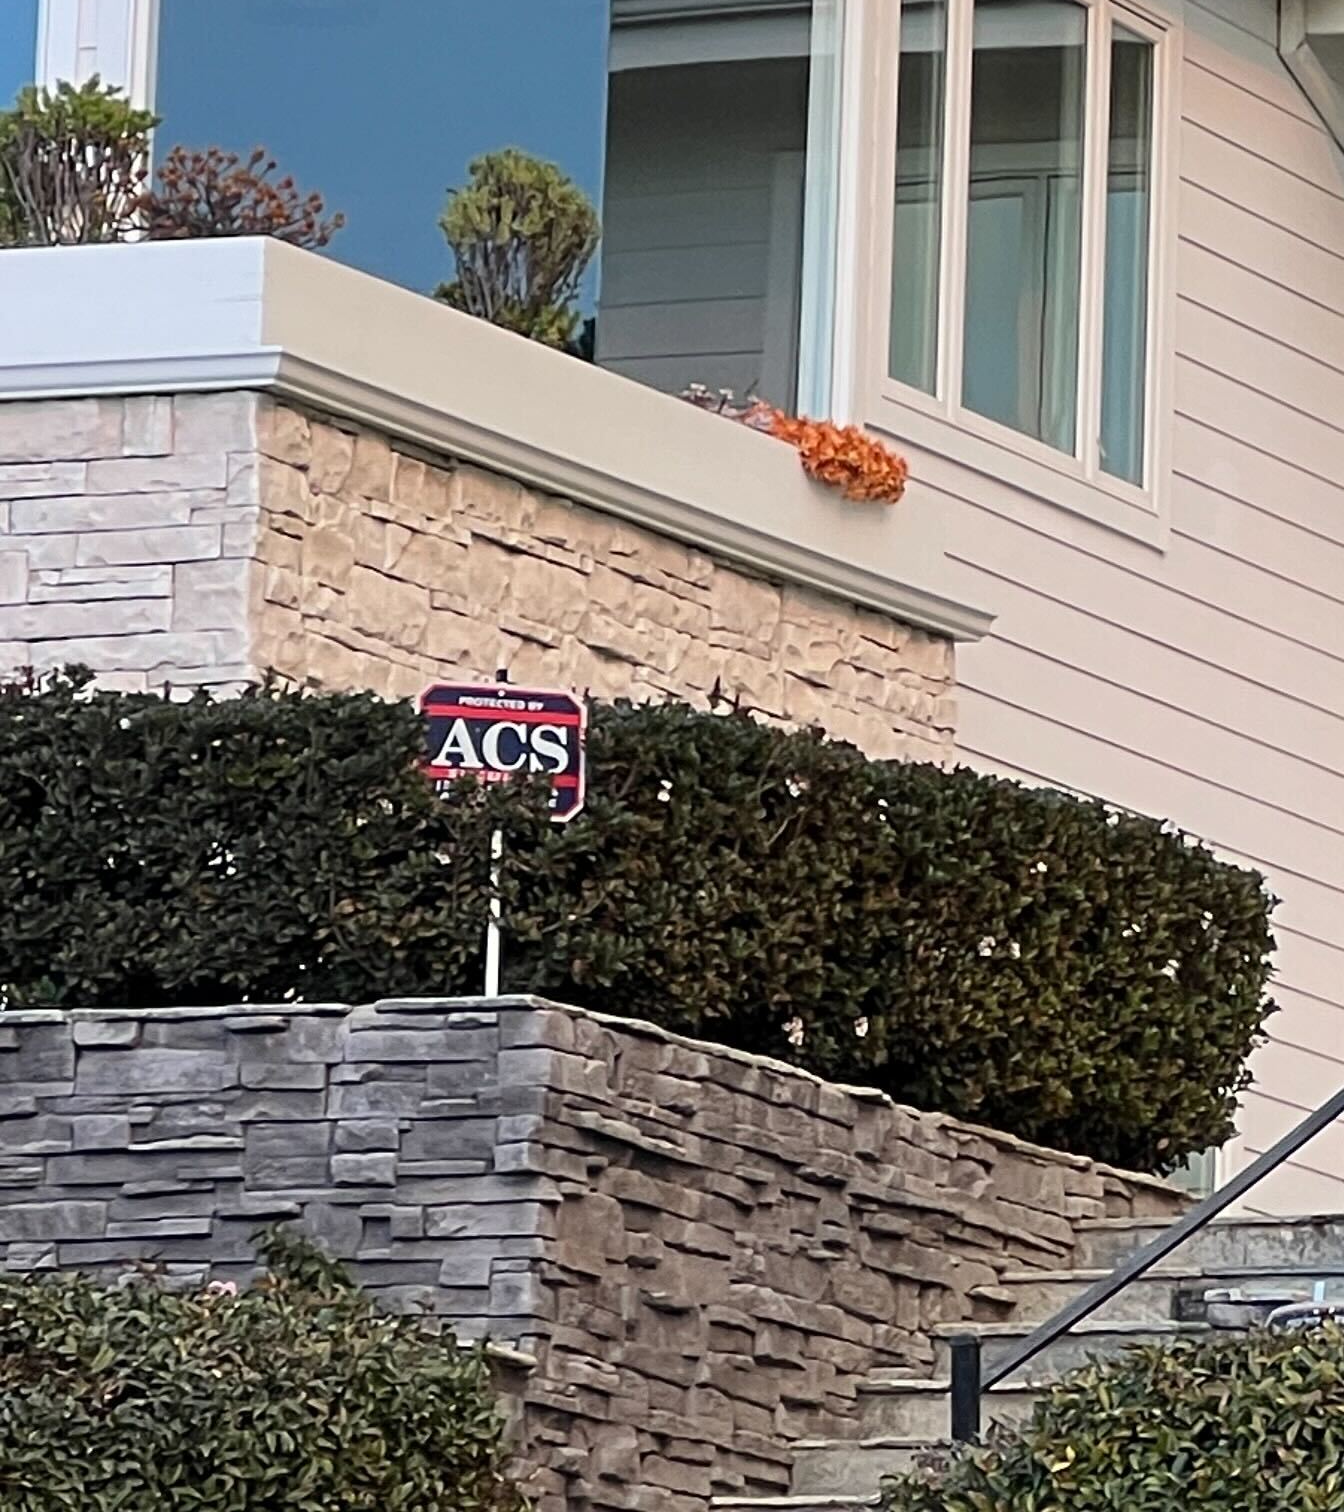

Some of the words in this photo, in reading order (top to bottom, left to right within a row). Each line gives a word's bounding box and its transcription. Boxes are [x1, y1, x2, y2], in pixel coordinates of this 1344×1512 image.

[459, 696, 525, 710] PROTECTED
[528, 701, 544, 711] BY
[431, 718, 569, 774] ACS
